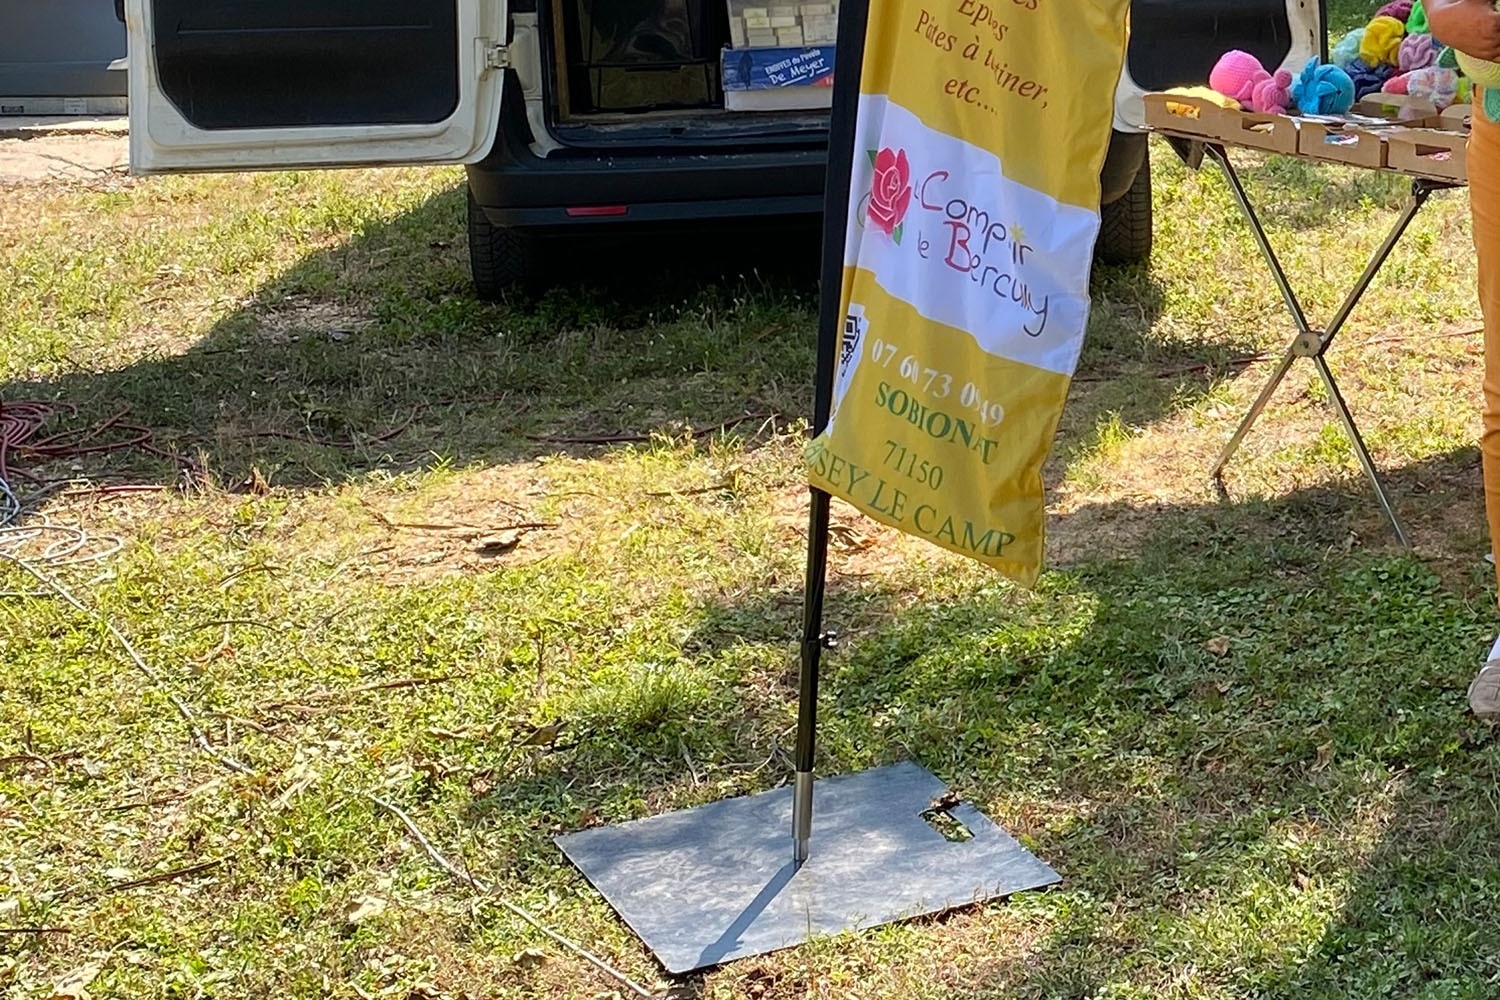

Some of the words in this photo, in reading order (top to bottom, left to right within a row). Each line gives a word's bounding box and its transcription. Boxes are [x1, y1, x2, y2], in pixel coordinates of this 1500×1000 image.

[769, 73, 786, 84] De
[790, 58, 824, 77] Meyer
[962, 35, 979, 61] à
[872, 339, 898, 368] 07
[924, 368, 952, 398] 73
[884, 440, 943, 491] 71150
[867, 480, 907, 522] LE
[914, 504, 1015, 558] CAMP
